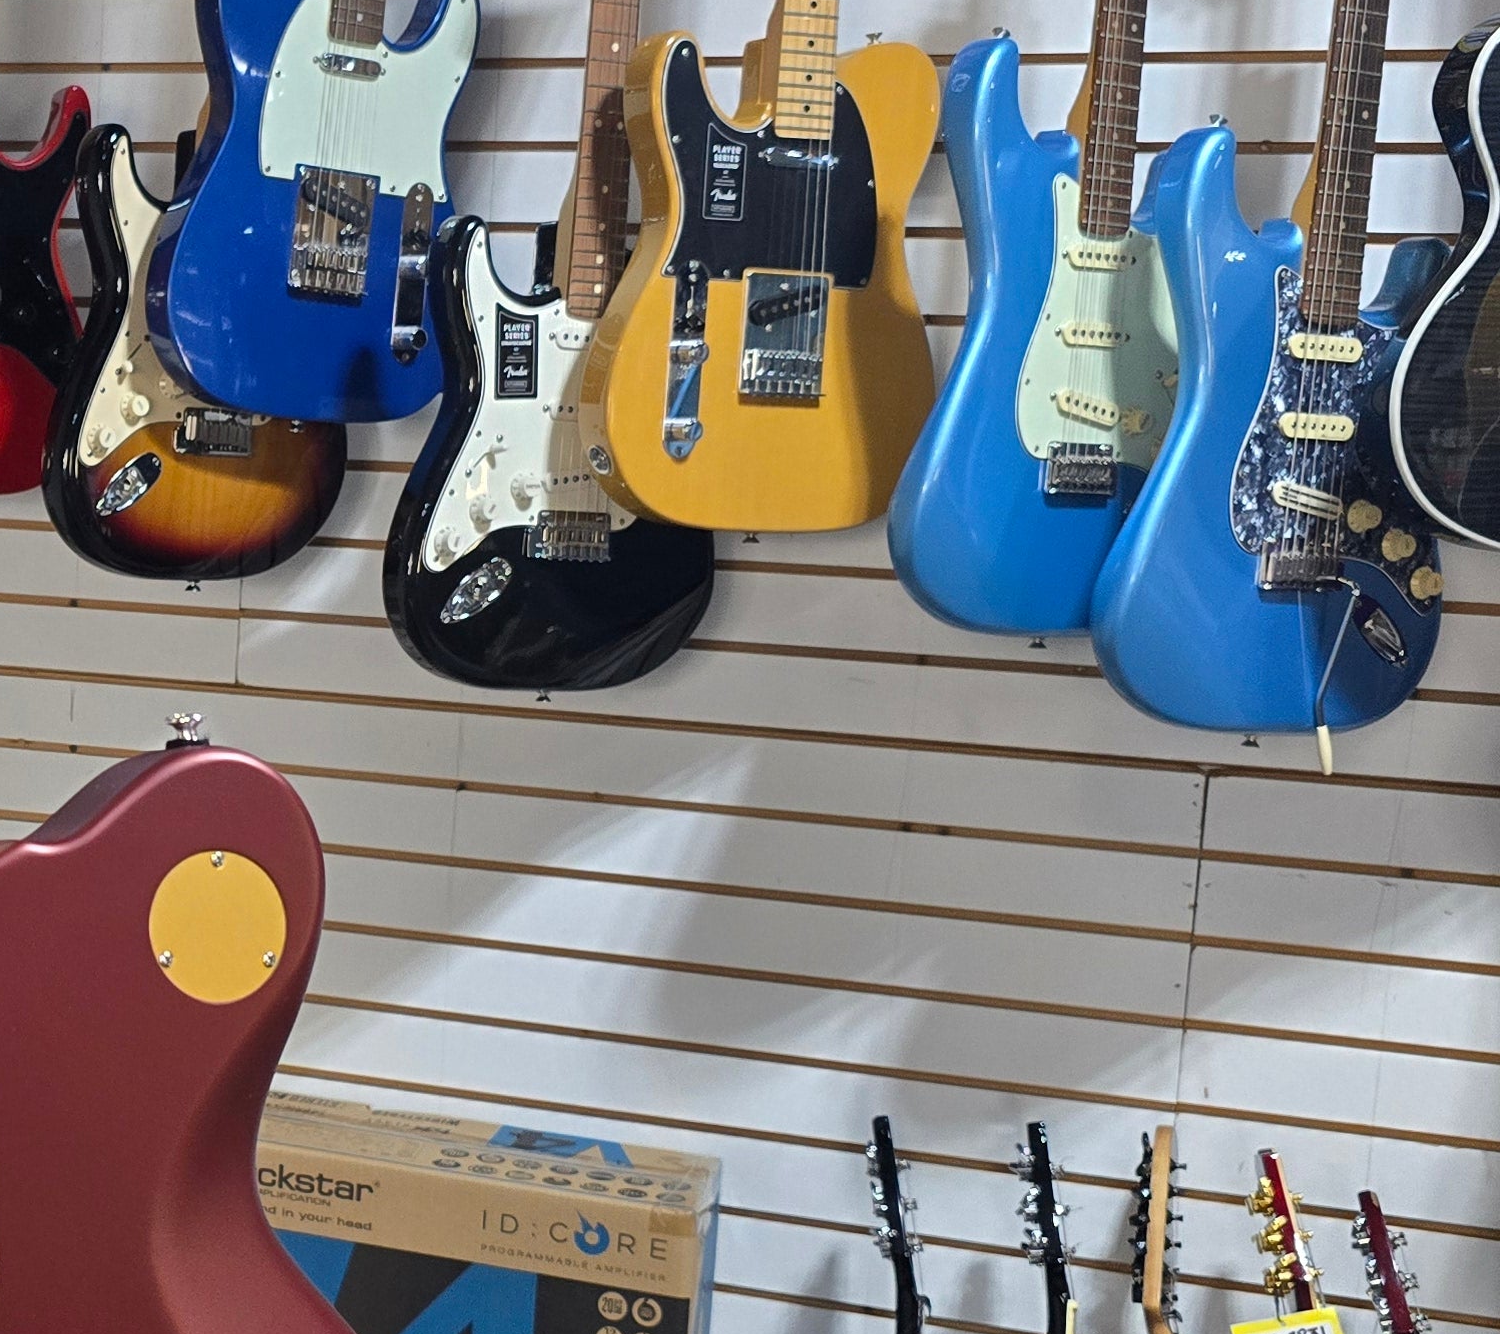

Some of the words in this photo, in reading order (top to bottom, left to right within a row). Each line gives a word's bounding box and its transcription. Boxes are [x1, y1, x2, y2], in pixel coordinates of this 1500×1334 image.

[712, 144, 743, 155] PLAYER
[713, 153, 741, 163] SERIES
[503, 323, 531, 332] PLAYER
[282, 1208, 294, 1218] in
[299, 1211, 334, 1225] your
[336, 1216, 372, 1231] head
[480, 1243, 589, 1269] PROGRAMMABLE
[595, 1263, 666, 1282] AMPLIFIER
